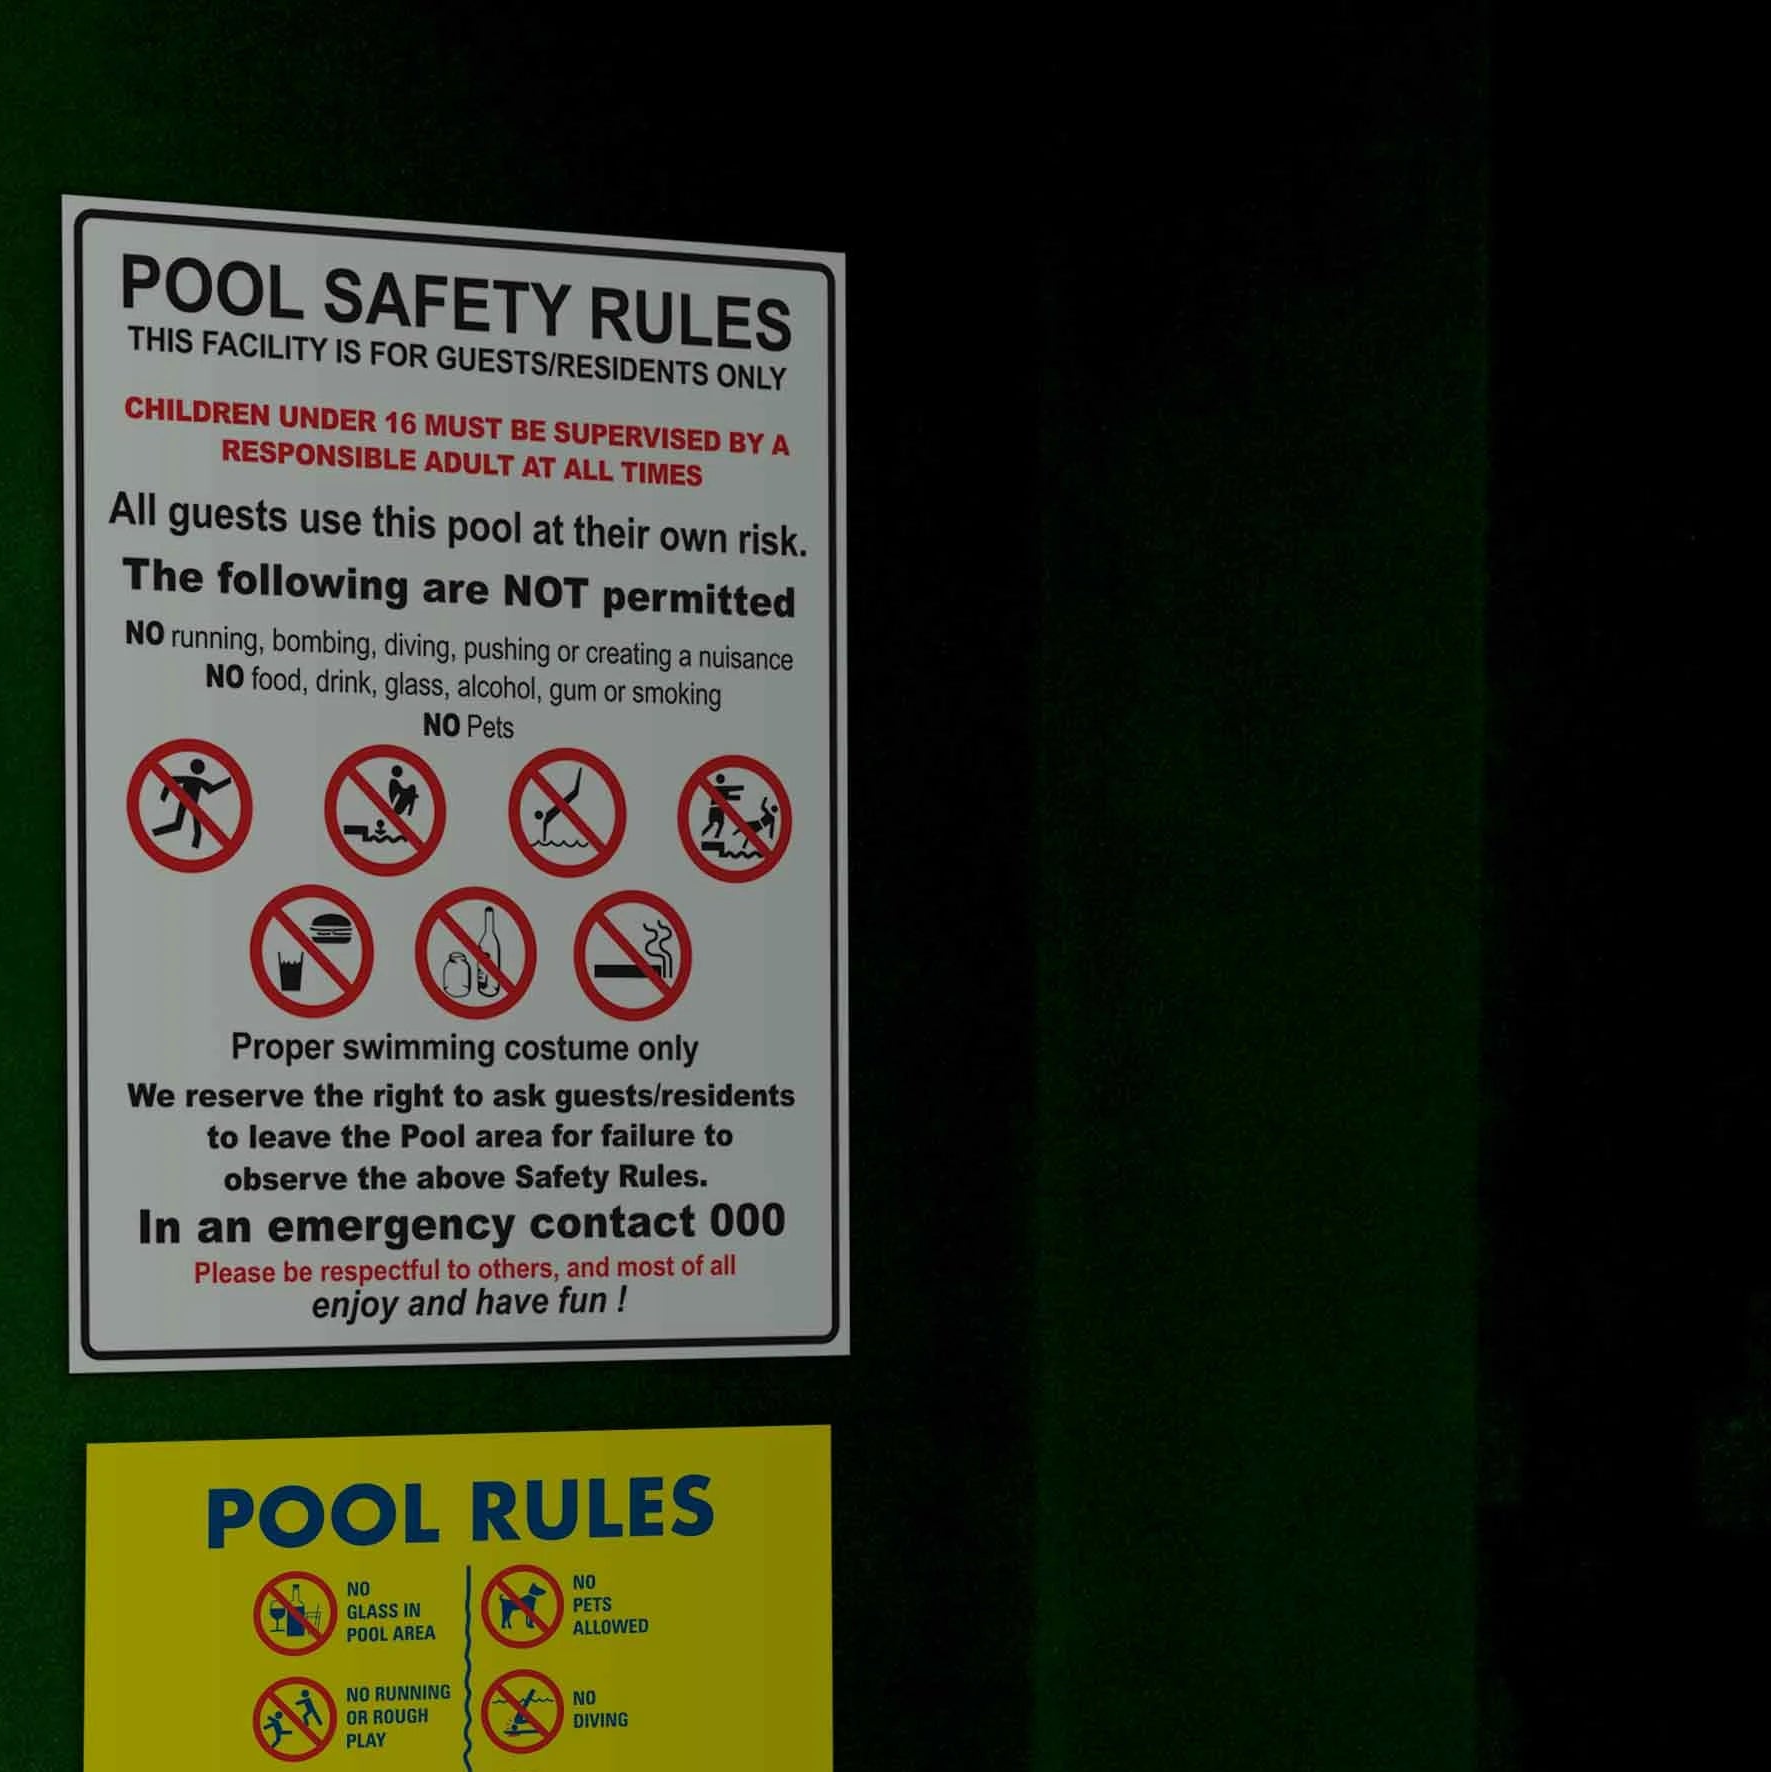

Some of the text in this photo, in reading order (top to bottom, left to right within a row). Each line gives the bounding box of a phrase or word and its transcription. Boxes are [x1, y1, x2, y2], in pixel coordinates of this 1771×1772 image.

[123, 254, 791, 351] POOL SAFETY RULES
[128, 326, 787, 390] THIS FACILITY IS FOR GUESTS/RESIDENTS ONLY
[125, 396, 788, 455] CHILDREN UNDER 16 MUST BE SUPERVISED BY A
[222, 438, 703, 486] RESPONSIBLE ADULT AT ALL TIMES
[109, 491, 806, 557] All guests use this pool at their own risk.
[123, 557, 794, 618] The following are NOT permitted
[126, 620, 793, 672] NO running, bombing, diving, pushing or creating a nuisance
[207, 664, 720, 712] NO food, drink, glass, alcohol, gum or smoking
[424, 712, 514, 738] NO Pets
[233, 1032, 698, 1068] Proper swimming costume only
[128, 1083, 795, 1113] We reserve the right to ask guests/residents
[207, 1123, 733, 1149] to leave the Pool area for failure to
[225, 1164, 707, 1194] observe the above Safety Rules.
[140, 1203, 785, 1249] In an emergency contact 000
[195, 1255, 736, 1285] Please be respectful to others, and most of all
[313, 1285, 627, 1324] enjoy and have fun !
[208, 1474, 714, 1549] POOL RULES
[348, 1582, 369, 1596] NO
[573, 1575, 595, 1589] NO
[348, 1603, 420, 1619] GLASS IN
[573, 1597, 612, 1612] PETS
[347, 1625, 435, 1642] POOL AREA
[573, 1619, 648, 1635] ALLOWED
[347, 1684, 450, 1702] NO RUNNING
[573, 1691, 596, 1705] NO
[347, 1708, 428, 1725] OR ROUGH
[574, 1712, 628, 1728] DIVING
[347, 1733, 385, 1748] PLAY
